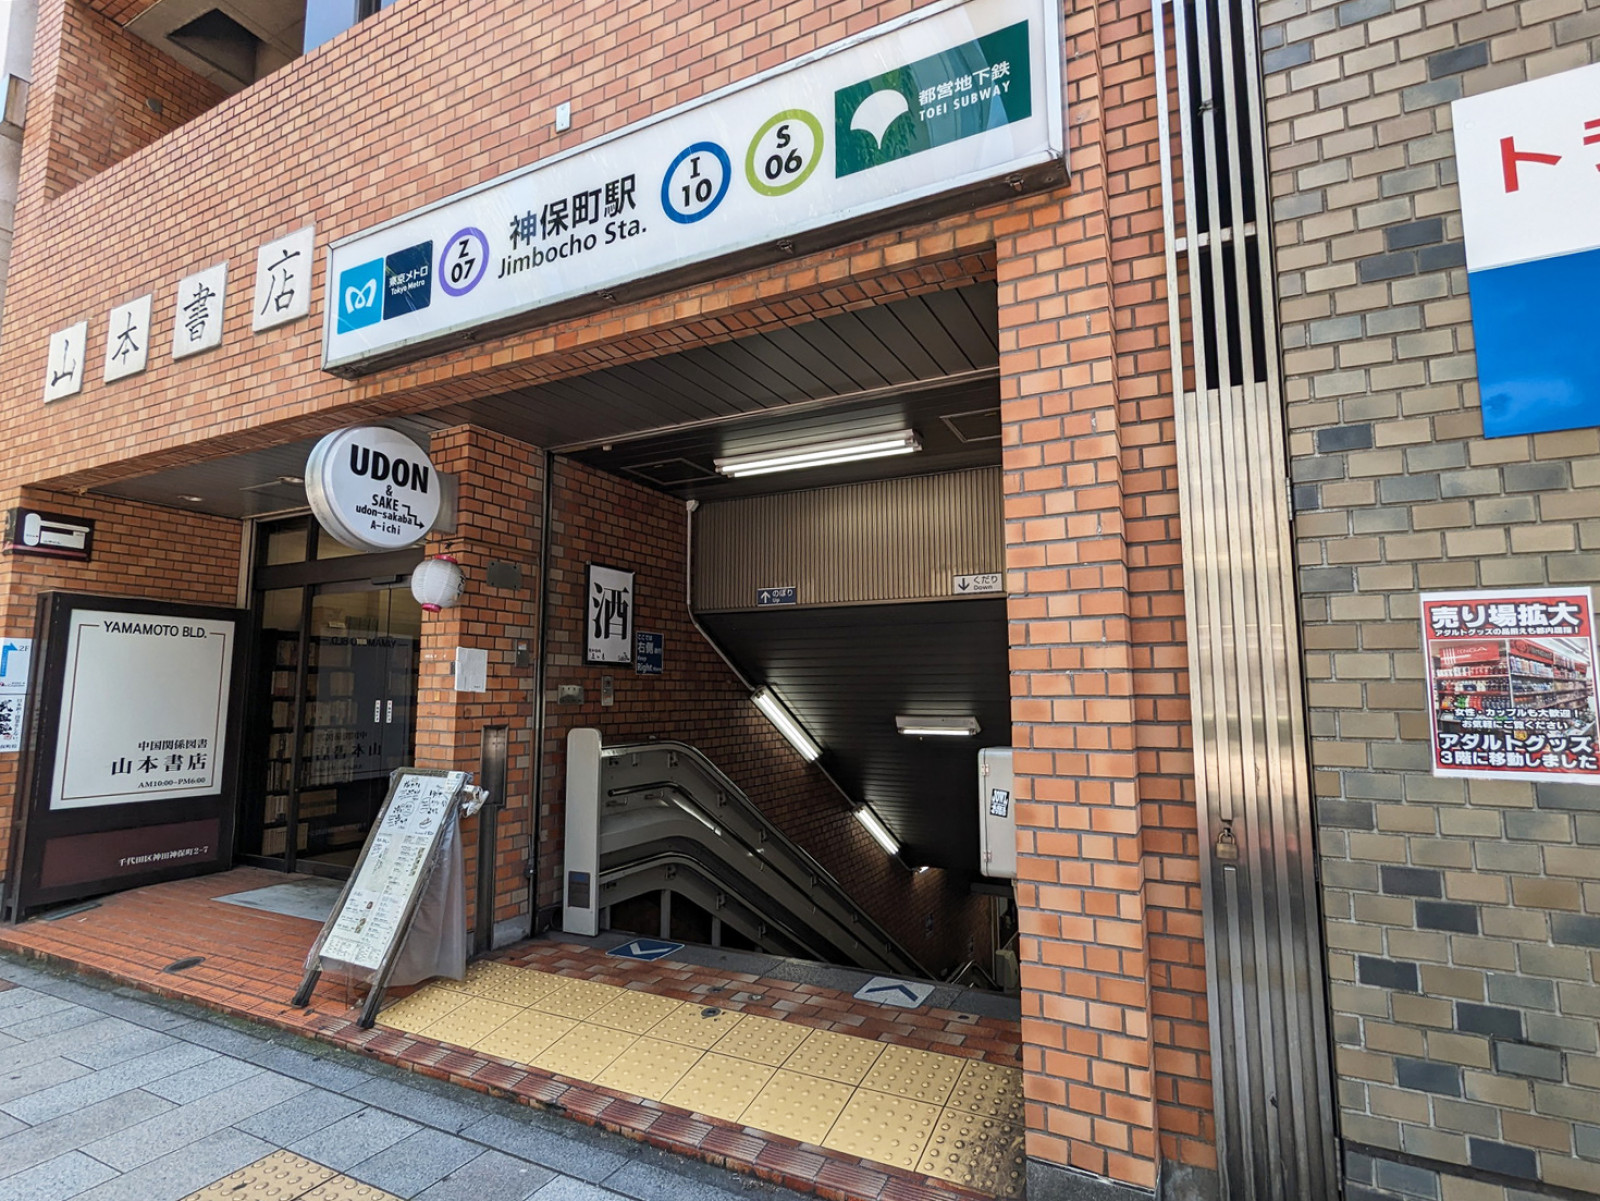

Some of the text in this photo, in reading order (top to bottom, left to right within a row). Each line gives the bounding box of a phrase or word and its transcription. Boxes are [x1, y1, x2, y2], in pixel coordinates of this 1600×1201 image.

[918, 60, 1010, 107] 都営地下鉄
[919, 80, 1010, 121] TOEI SUBWAY
[775, 125, 791, 149] S
[690, 157, 700, 179] I
[765, 148, 802, 180] 06
[682, 178, 712, 207] 10
[508, 174, 637, 250] 神保町駅
[458, 239, 469, 258] Z
[498, 218, 648, 278] Jimbocho Sta.
[389, 265, 428, 287] 東京メトロ
[451, 260, 475, 282] 07
[391, 279, 425, 295] Tokyo Metro
[350, 444, 429, 494] UDON
[386, 485, 393, 497] &
[372, 494, 399, 512] SAKE
[356, 505, 413, 525] udon-sakaba
[370, 520, 401, 535] A-ichi
[974, 575, 998, 584] くだり
[592, 582, 629, 640] 酒
[1430, 602, 1579, 629] 売り場拡大
[104, 621, 207, 638] YAMAMOTO BLD.
[637, 662, 653, 673] Right
[1461, 721, 1568, 730] お気軽にご覧ください
[138, 739, 207, 751] 中国関係図書
[1438, 733, 1593, 754] アダルトグッズ
[111, 752, 207, 776] 山本書店
